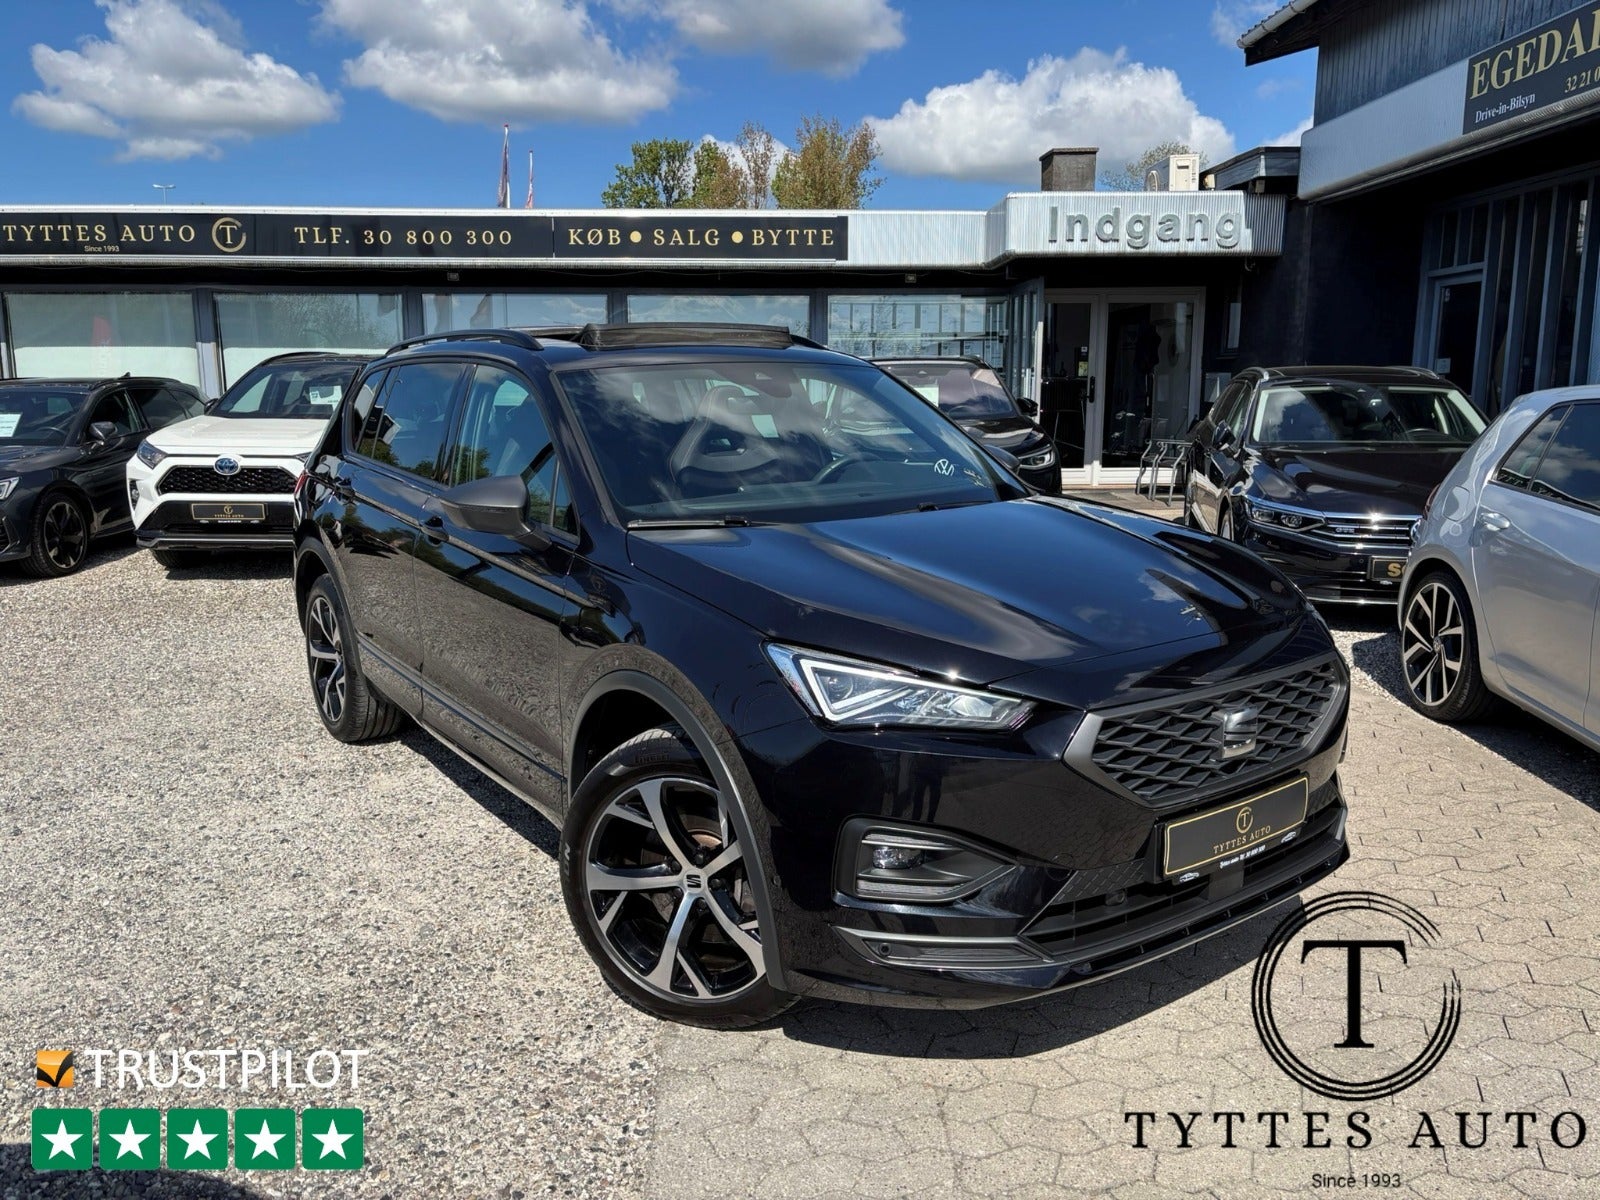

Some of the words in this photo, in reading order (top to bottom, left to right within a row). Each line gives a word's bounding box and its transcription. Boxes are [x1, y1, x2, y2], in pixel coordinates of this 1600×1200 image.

[1564, 75, 1577, 93] 32
[1579, 69, 1591, 88] 21
[1475, 93, 1536, 123] Drive-in-Bilsyn
[2, 224, 108, 242] TYTTES
[120, 224, 195, 242] AUTO
[294, 226, 350, 244] TLF.
[364, 229, 392, 245] 30
[406, 229, 453, 245] 800
[466, 229, 512, 246] 300
[568, 228, 622, 246] KØB
[653, 228, 721, 246] SALG
[752, 228, 834, 246] BYTTE
[1048, 205, 1242, 249] Indgang
[84, 244, 101, 252] Since
[102, 244, 120, 252] 1993
[1213, 835, 1247, 854] TYTTES
[1249, 825, 1271, 841] AUTO
